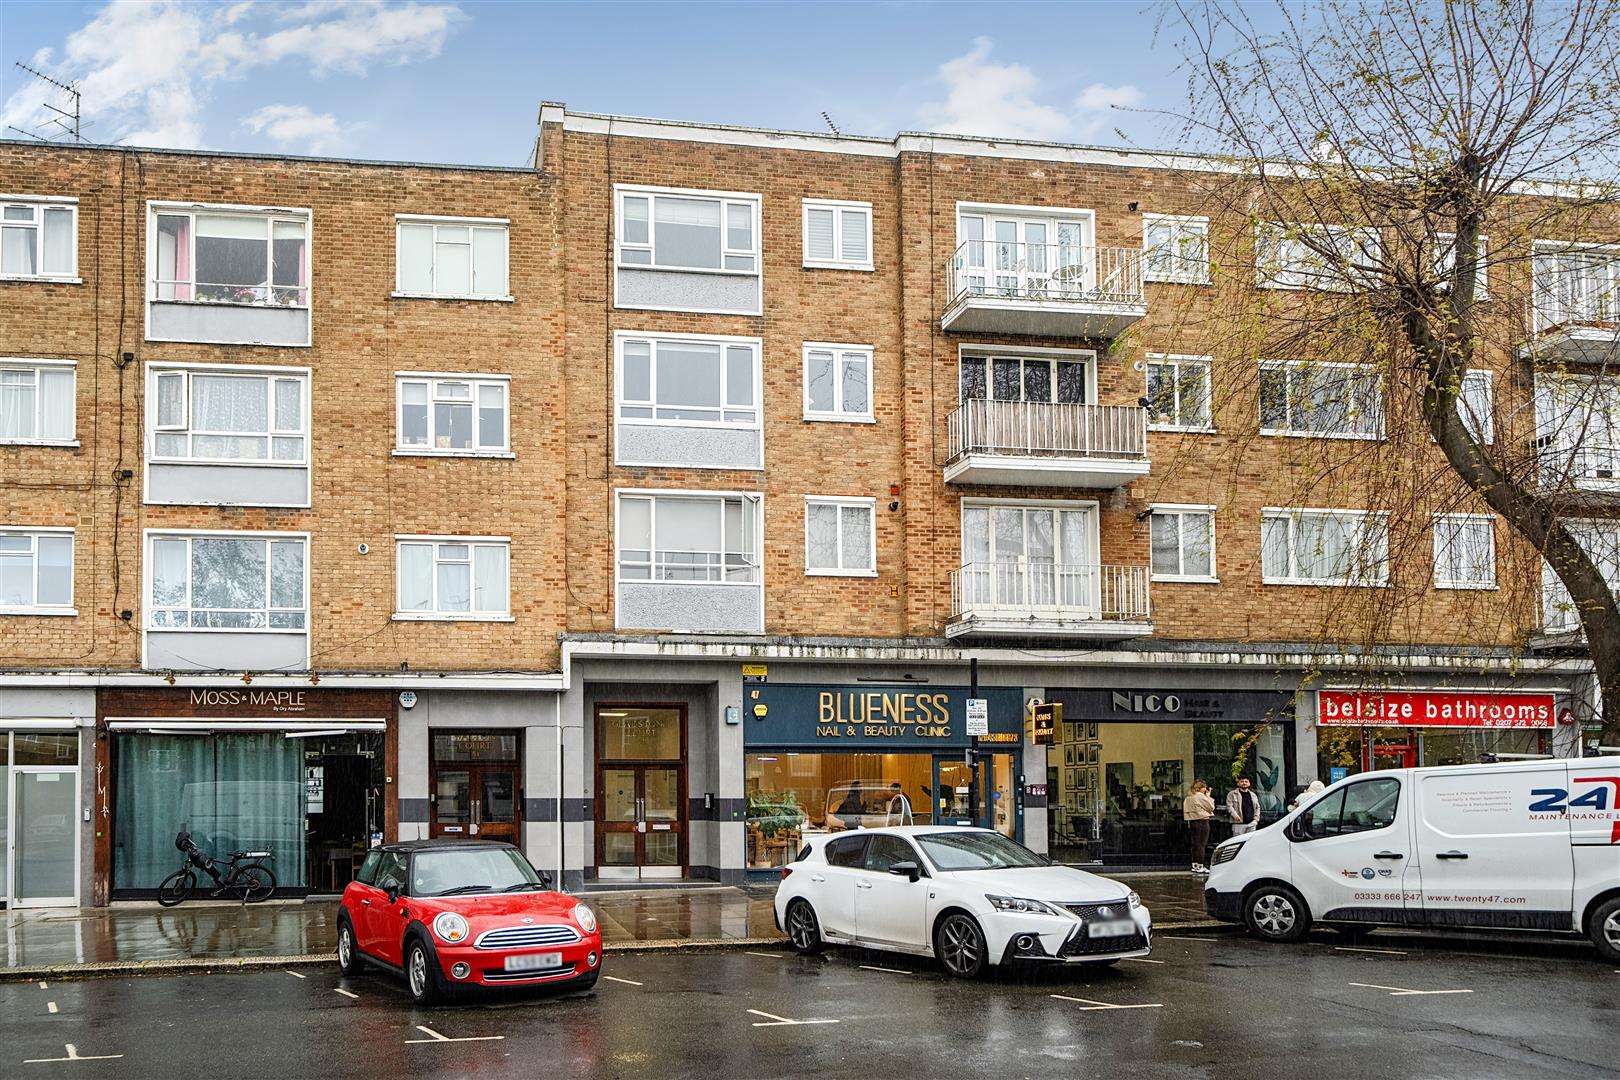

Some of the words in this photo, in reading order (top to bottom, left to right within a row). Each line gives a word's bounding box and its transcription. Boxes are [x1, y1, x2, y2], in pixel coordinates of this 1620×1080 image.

[190, 689, 240, 705] MOSS
[250, 691, 306, 706] MAPLE
[1112, 691, 1181, 712] NICO
[819, 692, 950, 724] BLUENESS
[1326, 697, 1413, 718] belsize
[1426, 700, 1549, 719] bathrooms
[816, 726, 841, 736] NAIL
[846, 726, 856, 736] &
[864, 726, 906, 736] BEAUTY
[915, 726, 951, 737] CLINIC
[1528, 813, 1612, 821] MAINTENANCE
[1354, 892, 1381, 900] 03333
[1403, 893, 1421, 901] 247
[1427, 895, 1526, 904] www.twenty47.com
